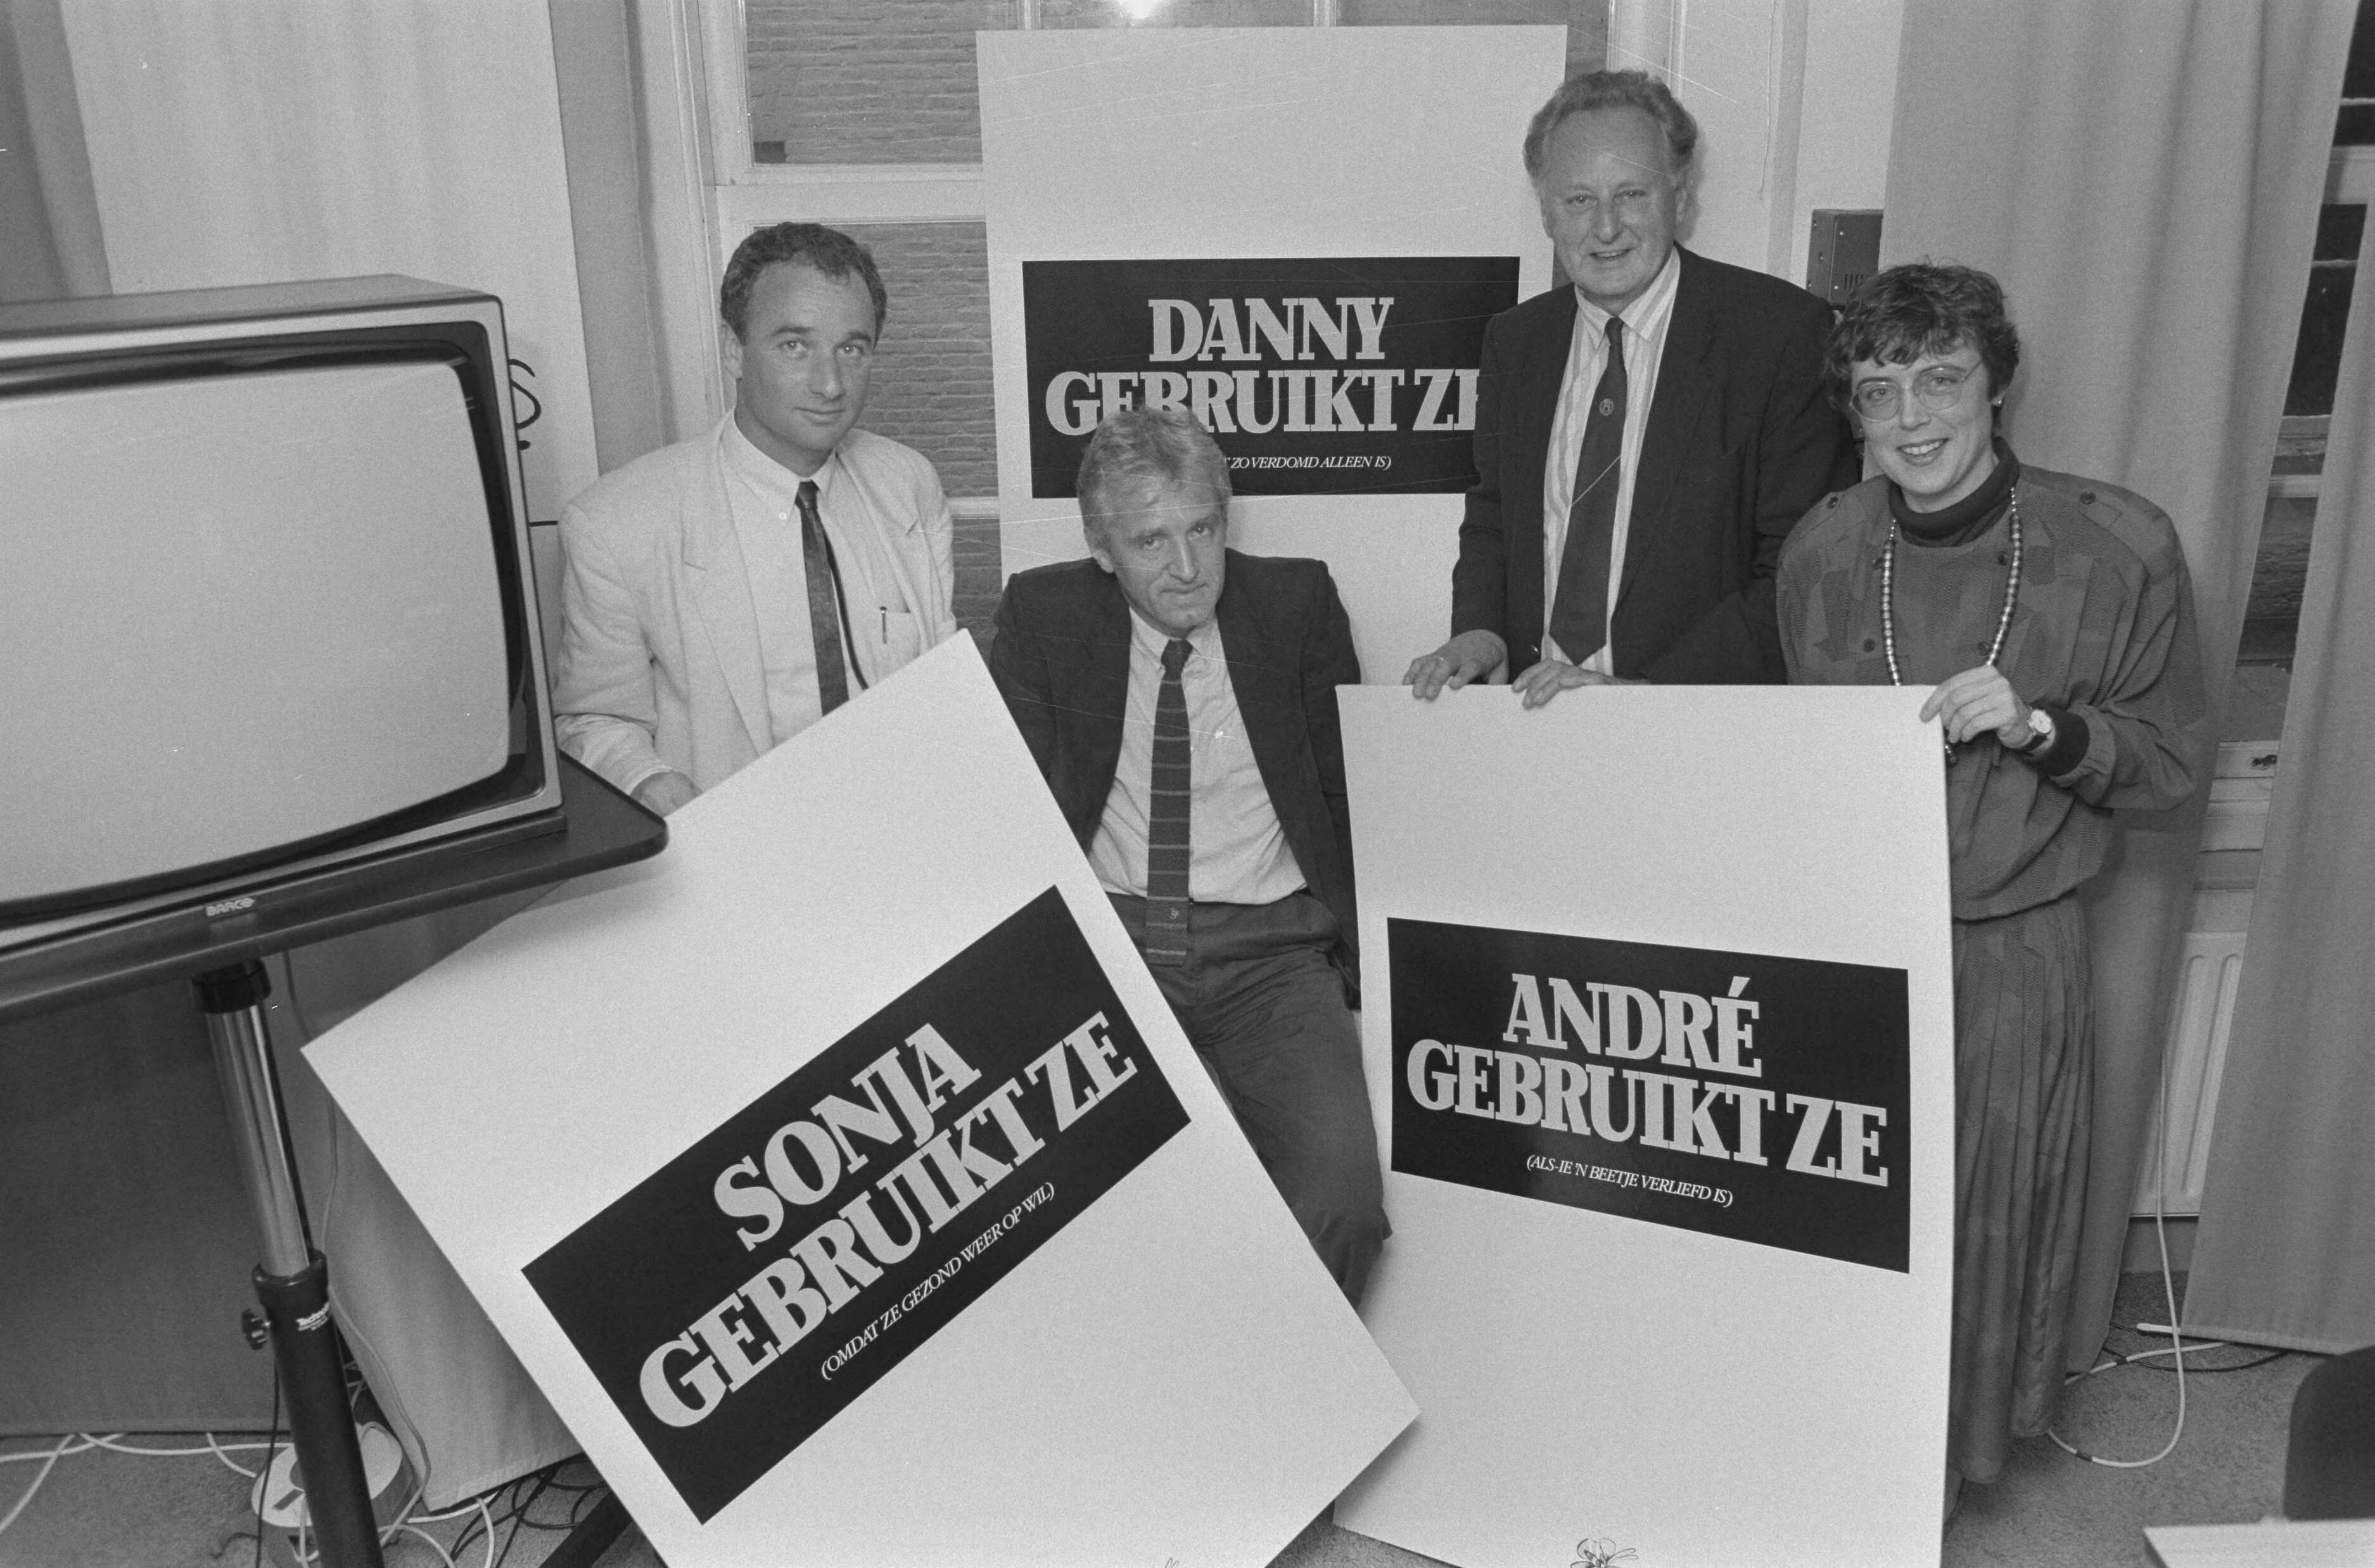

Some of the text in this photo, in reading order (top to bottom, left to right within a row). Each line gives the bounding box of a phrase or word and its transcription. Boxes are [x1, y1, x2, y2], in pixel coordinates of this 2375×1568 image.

[1148, 296, 1394, 362] DANNY
[1045, 369, 1404, 436] GEBRUIKT
[1230, 456, 1251, 469] ZO
[1251, 456, 1319, 469] VERDOMD
[1320, 456, 1373, 468] ALLEEN
[1374, 456, 1392, 471] IS)
[206, 897, 255, 917] BARCO
[1503, 972, 1762, 1078] ANDRÉ
[714, 1023, 982, 1252] SONJA
[1407, 1039, 1888, 1187] GEBRUIKT ZE
[640, 1010, 1138, 1427] GEBRUIKT ZE
[1589, 1166, 1640, 1188] BEETJE
[1641, 1175, 1711, 1201] VERLIEFD
[1712, 1188, 1733, 1208] IS)
[821, 1182, 1055, 1380] (OMDAT ZE GEZOND WEER OP WIL)
